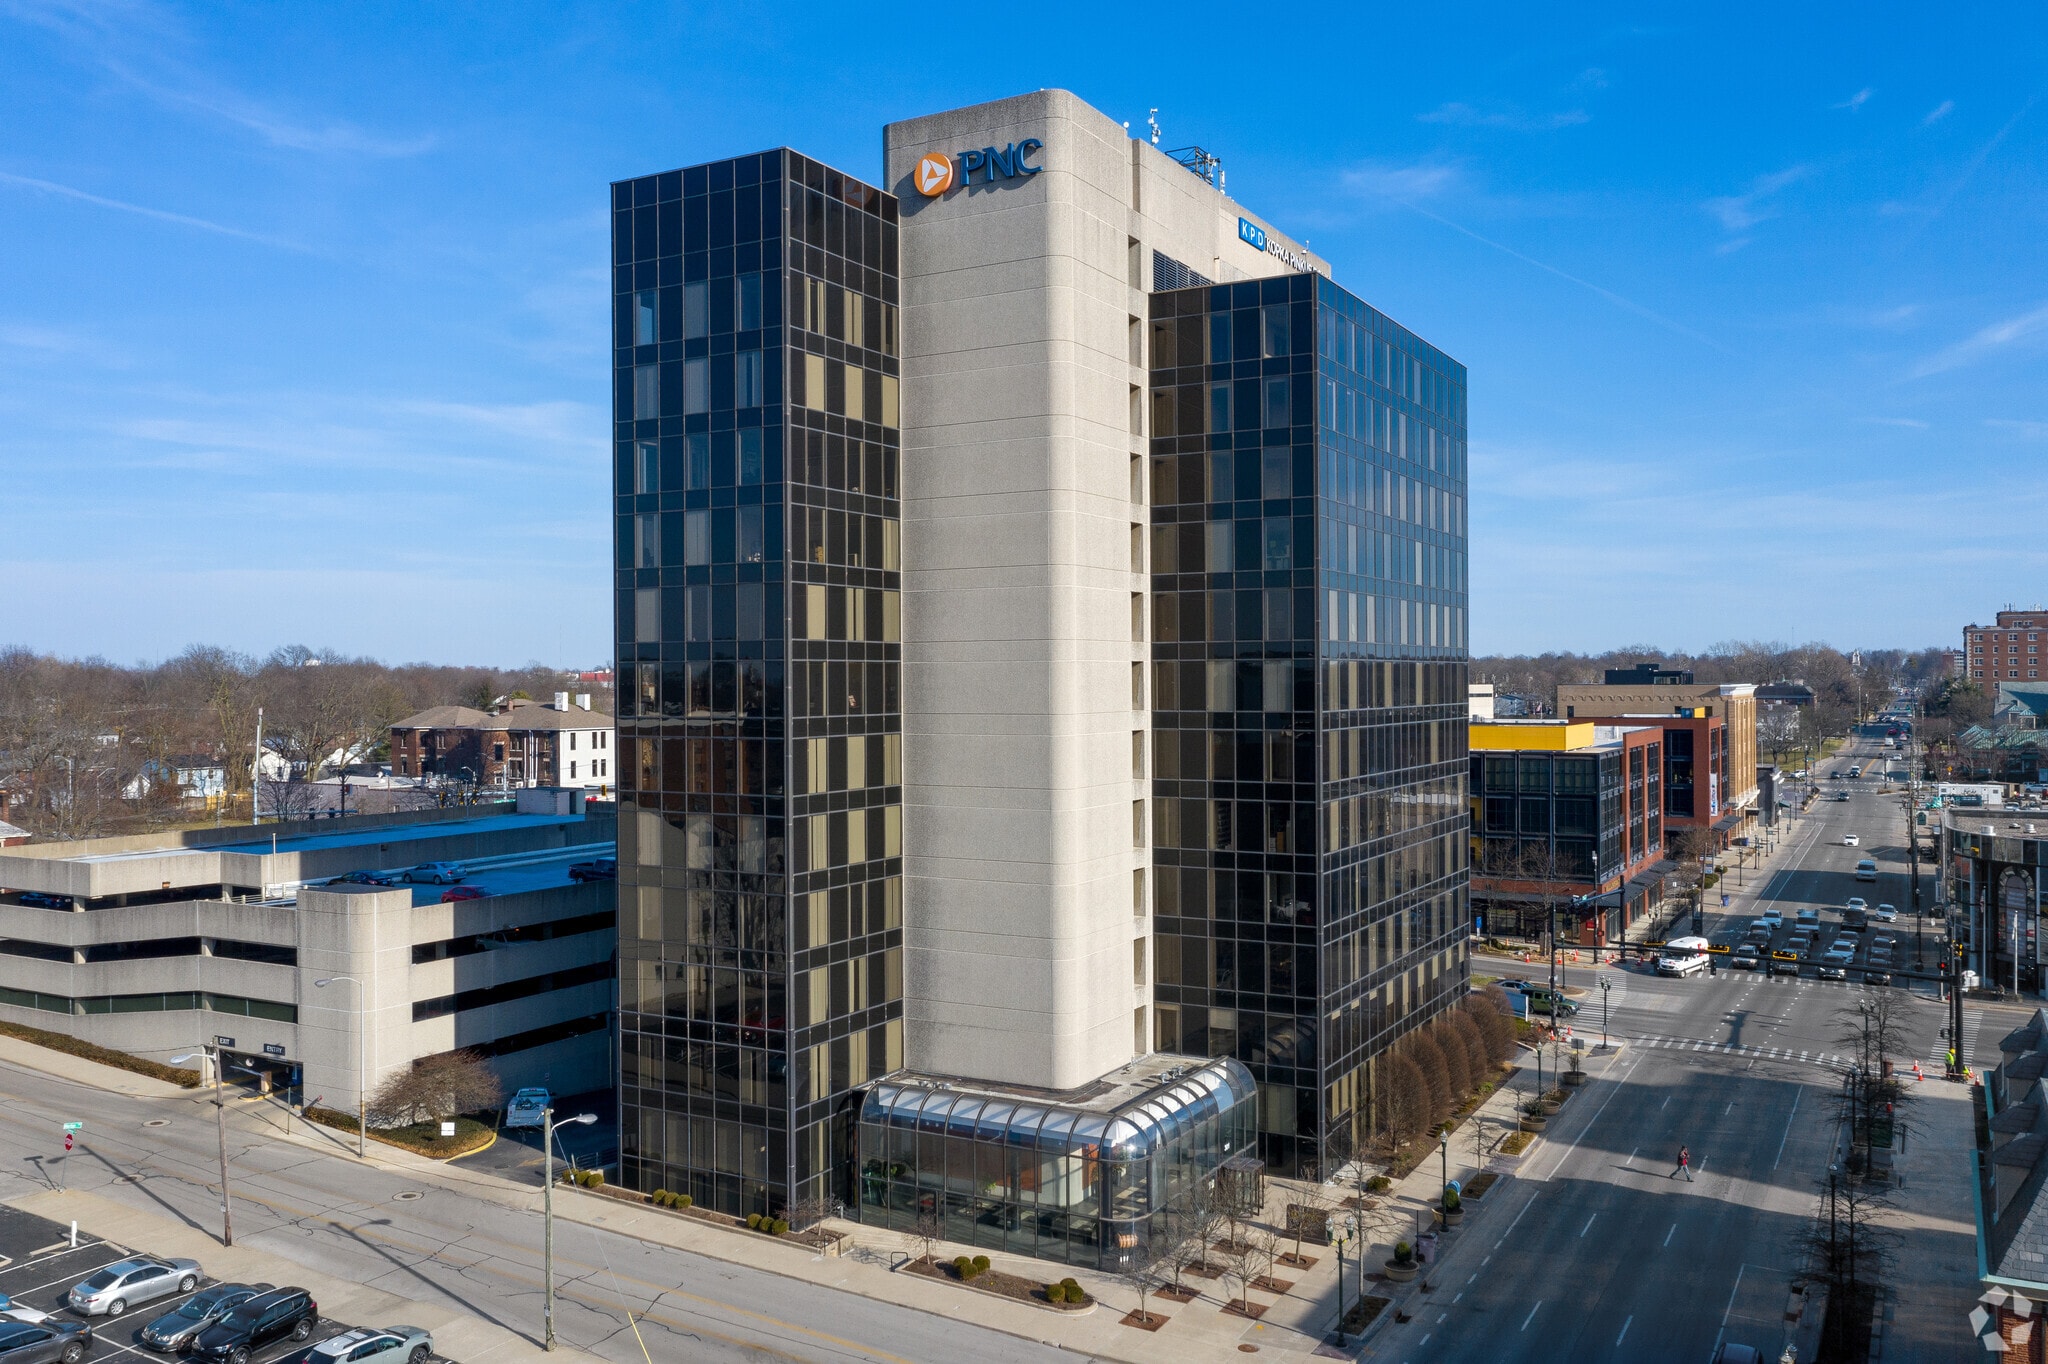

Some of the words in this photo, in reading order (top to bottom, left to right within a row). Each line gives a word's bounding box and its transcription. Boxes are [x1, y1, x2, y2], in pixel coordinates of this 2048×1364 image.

[957, 138, 1044, 186] PNC
[1242, 221, 1263, 246] KPD
[1266, 238, 1289, 264] KOPKA
[266, 1045, 282, 1053] ENTRY
